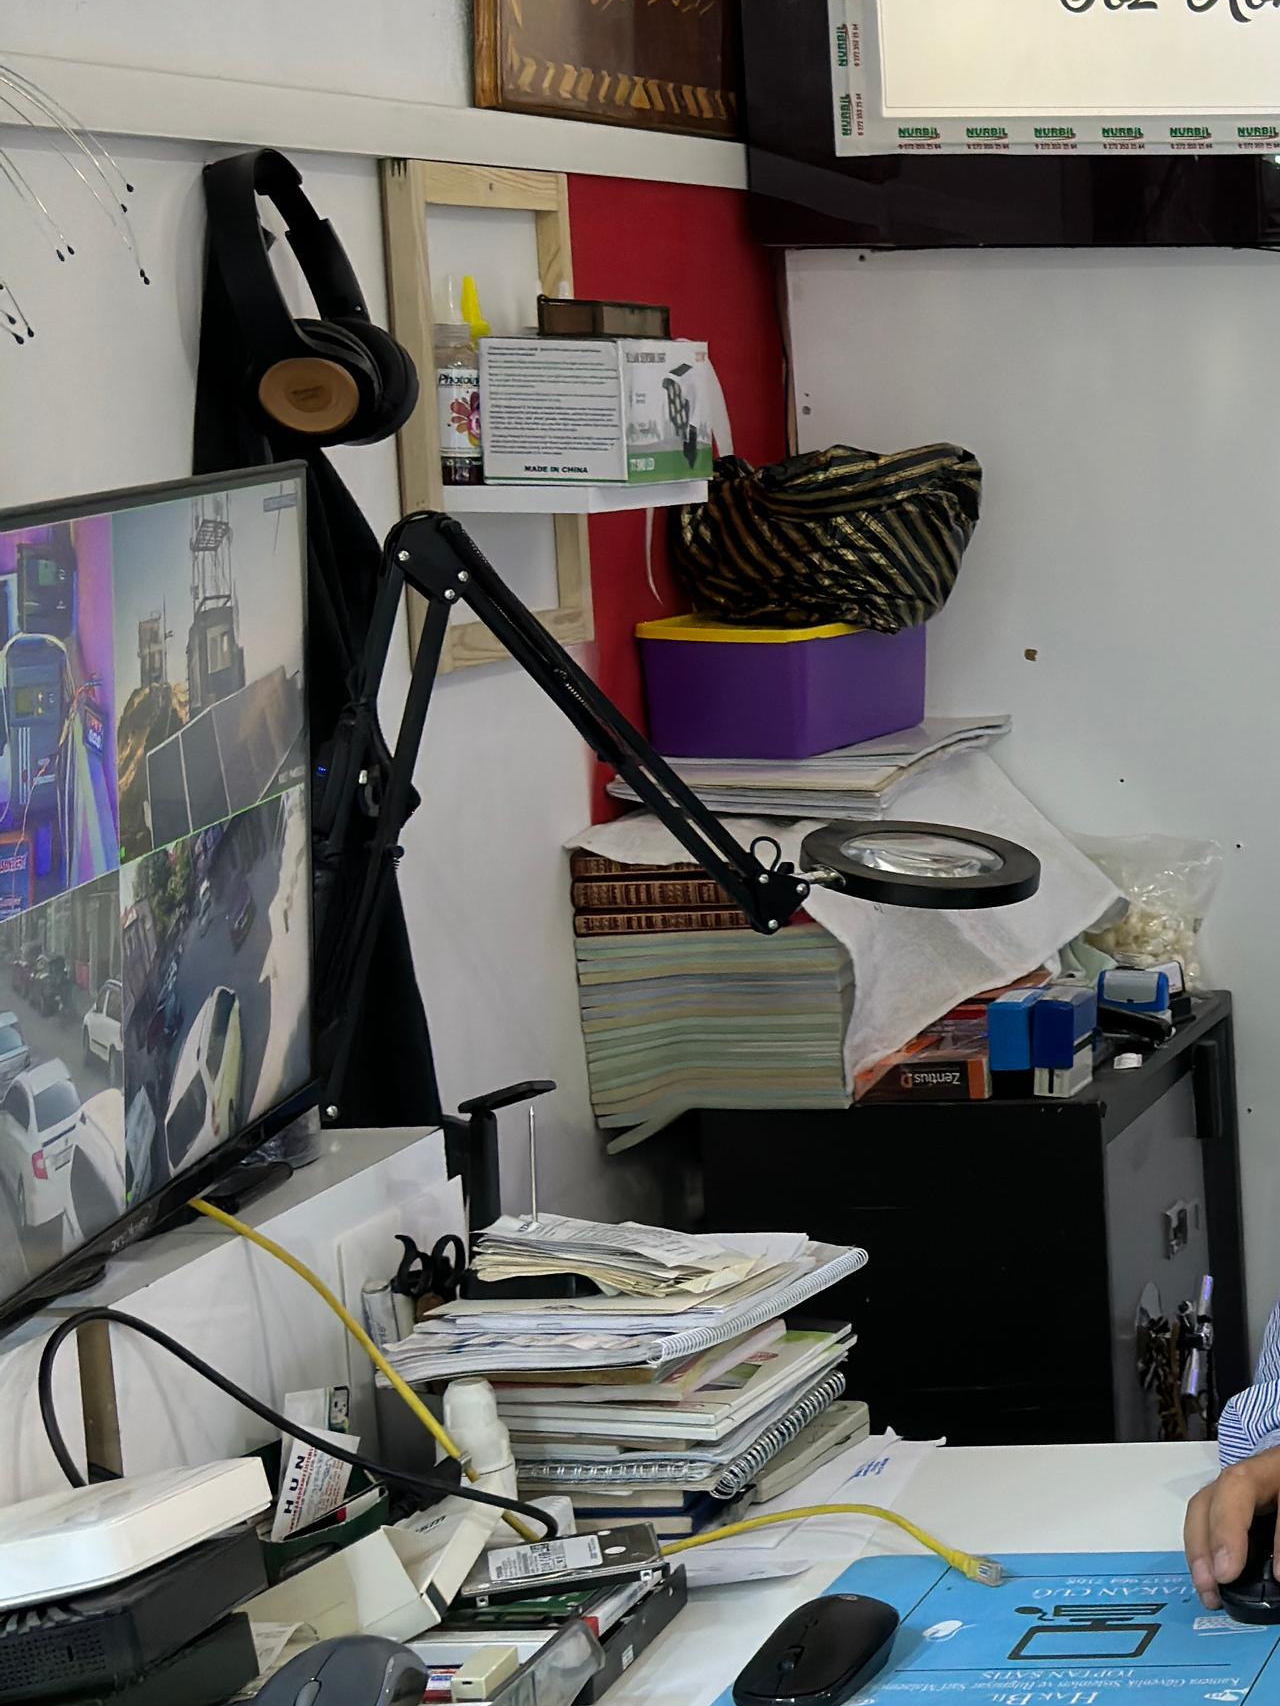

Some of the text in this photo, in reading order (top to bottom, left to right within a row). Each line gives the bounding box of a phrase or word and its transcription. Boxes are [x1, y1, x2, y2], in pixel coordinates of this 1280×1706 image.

[524, 465, 548, 473] MADE
[561, 466, 588, 474] CHINA
[913, 1072, 961, 1087] Zentius
